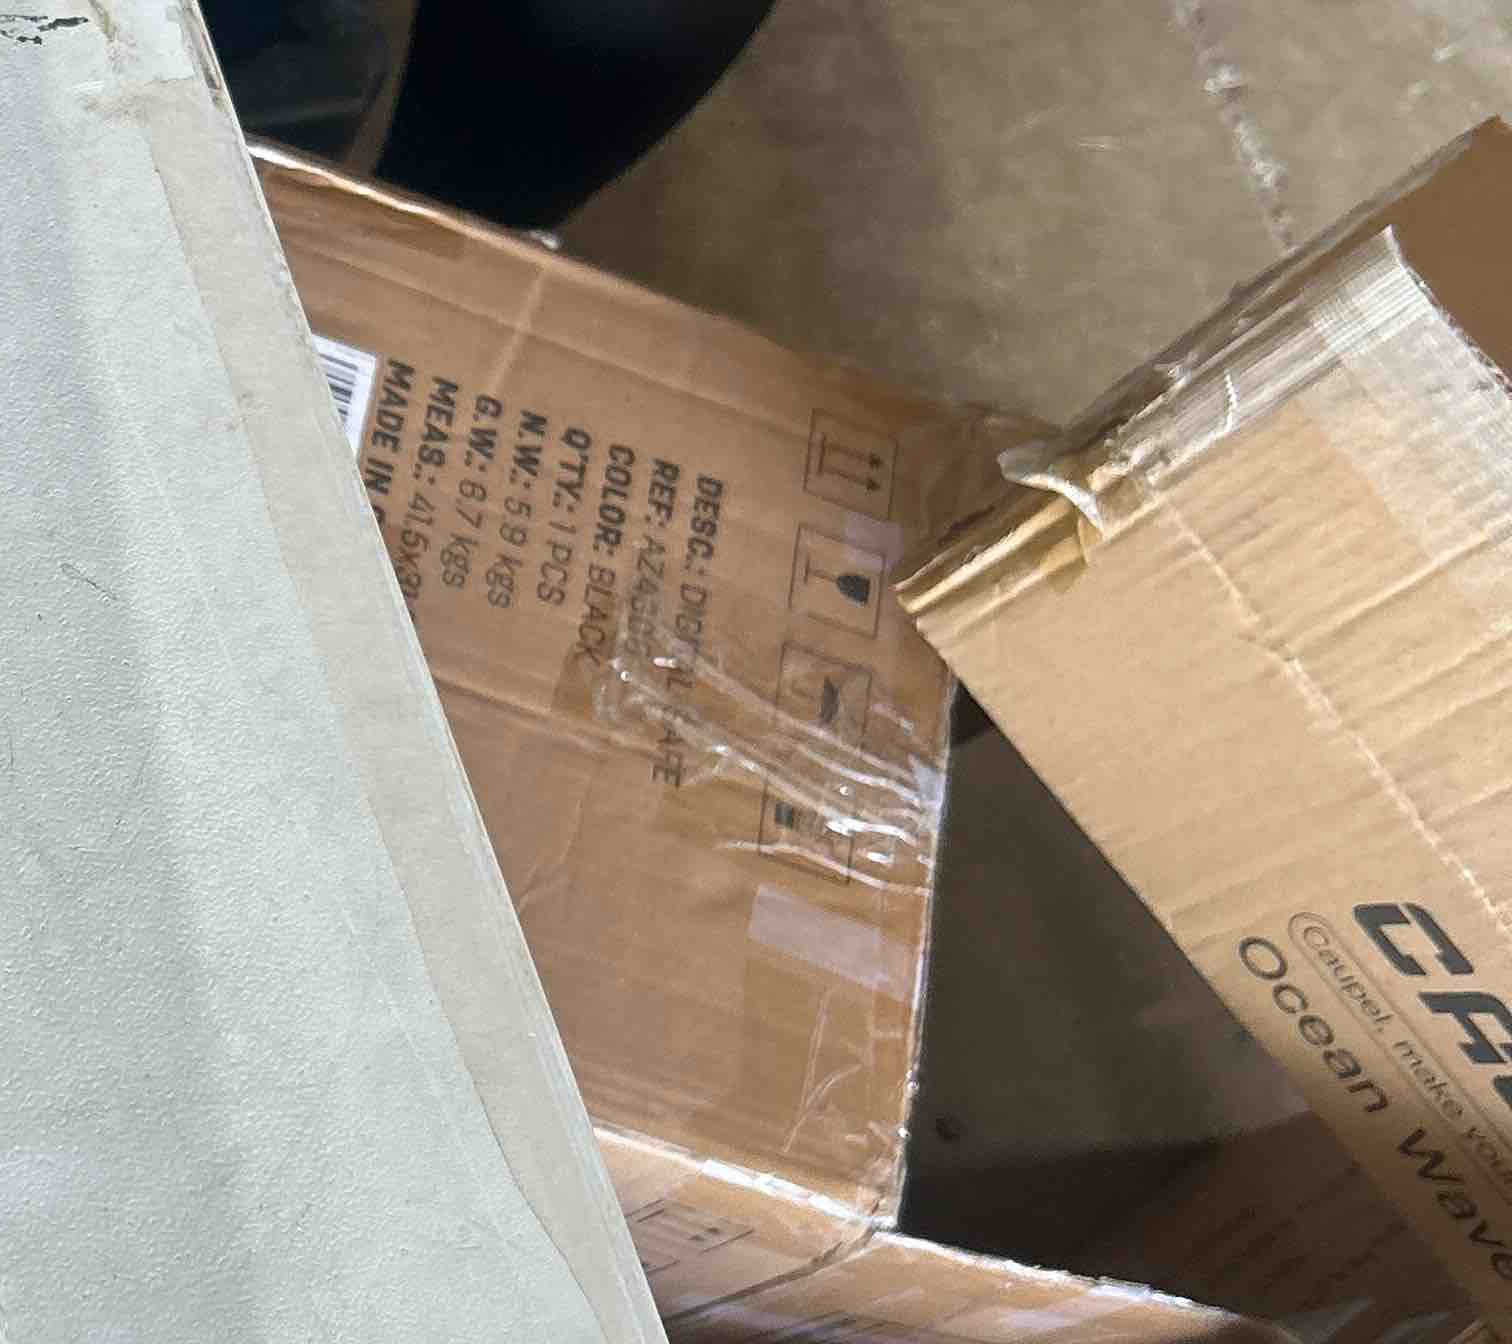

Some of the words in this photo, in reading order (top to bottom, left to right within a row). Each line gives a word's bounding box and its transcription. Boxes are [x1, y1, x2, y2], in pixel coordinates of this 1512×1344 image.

[371, 359, 416, 454] MADE
[362, 456, 394, 496] IN
[593, 443, 635, 556] COLOR:
[645, 458, 681, 528] REF:
[440, 532, 479, 590] kgs
[485, 553, 524, 609] kgs
[537, 540, 573, 606] PCS
[576, 563, 616, 667] BLACK
[1238, 936, 1388, 1113] Ocean
[1393, 1040, 1463, 1121] make
